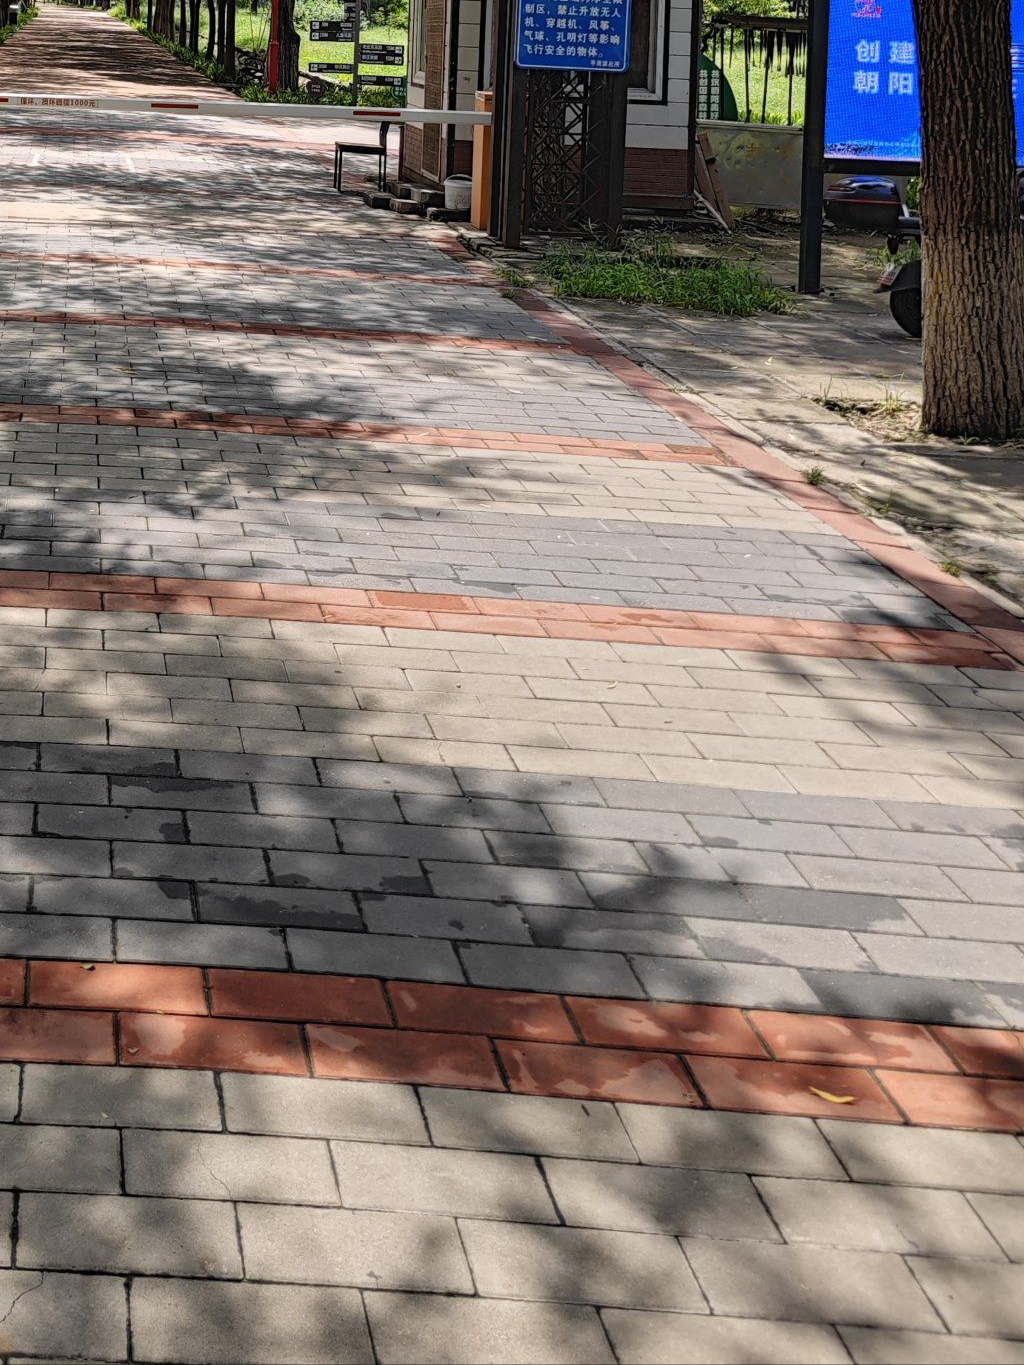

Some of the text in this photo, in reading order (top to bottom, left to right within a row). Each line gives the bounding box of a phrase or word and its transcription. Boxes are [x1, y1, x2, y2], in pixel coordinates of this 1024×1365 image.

[523, 30, 620, 45] 气球、孔明灯等影响
[855, 39, 916, 64] 创建
[853, 71, 914, 95] 朝阳
